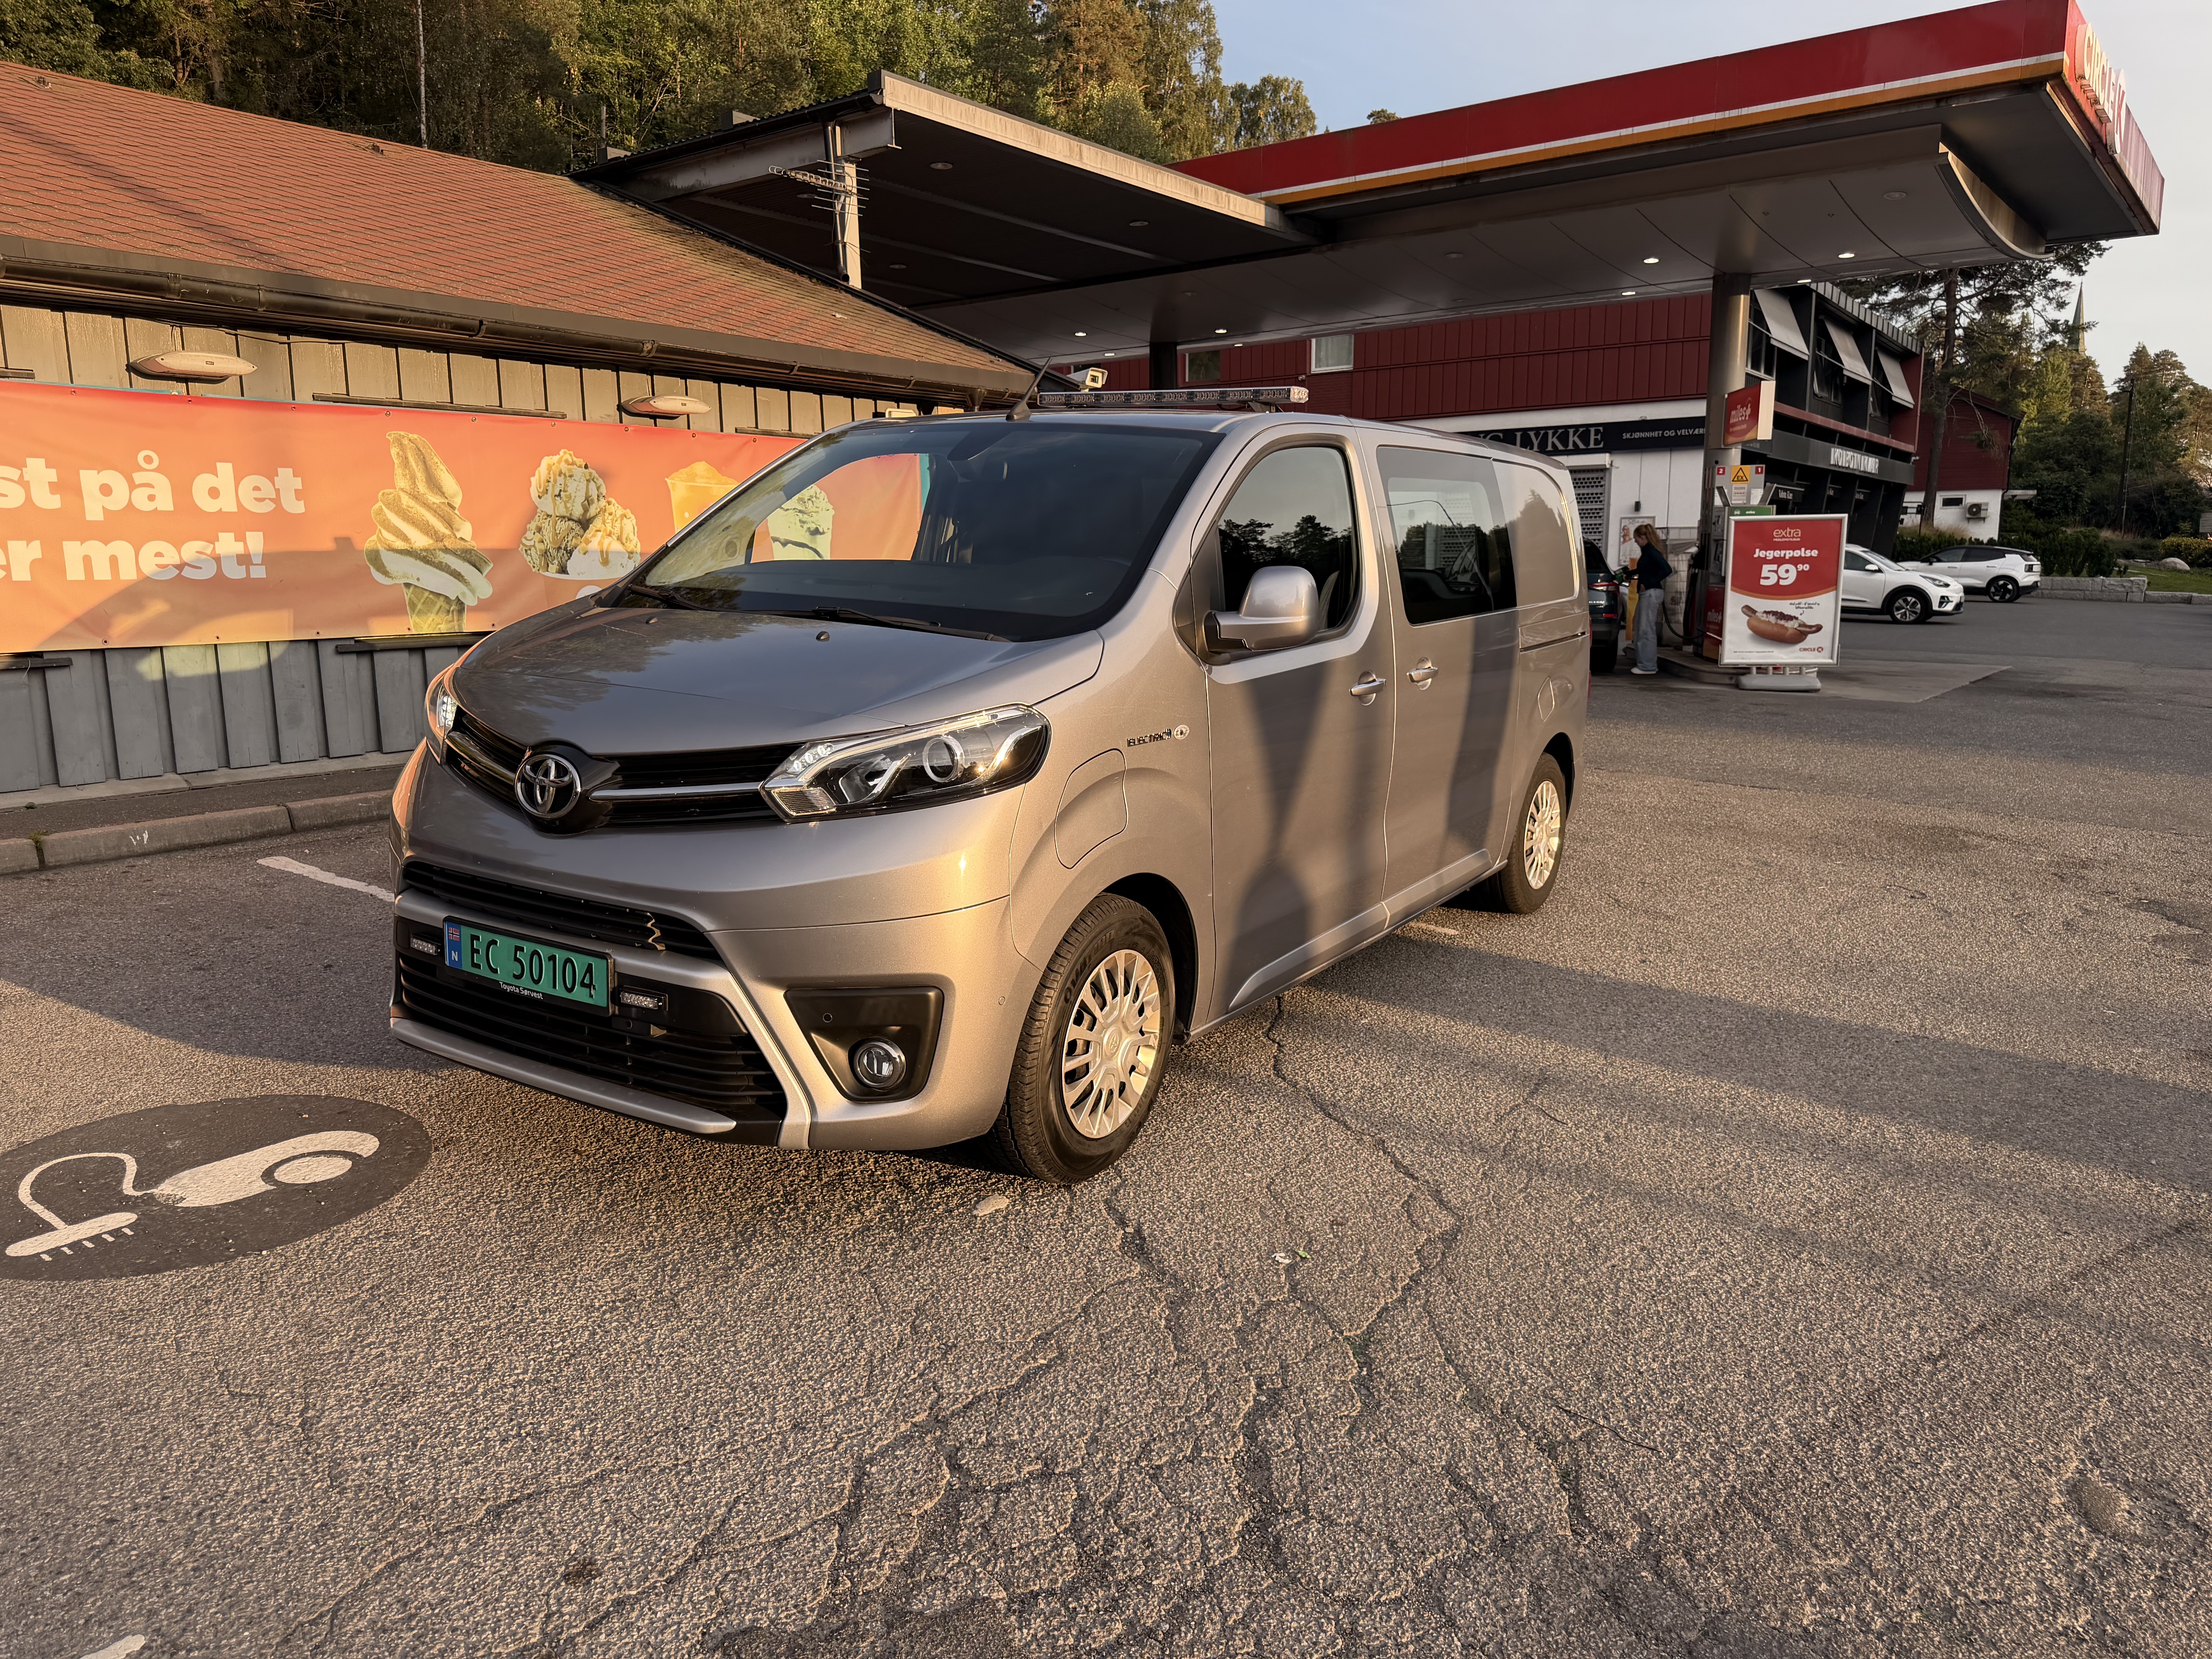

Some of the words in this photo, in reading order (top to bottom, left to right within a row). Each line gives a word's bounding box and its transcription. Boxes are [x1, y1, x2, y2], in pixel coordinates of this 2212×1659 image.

[2083, 22, 2116, 122] CIRCLE
[1515, 426, 1604, 452] LYKKE
[1622, 431, 1662, 439] SKJØNNHET
[79, 450, 174, 521] på
[192, 462, 305, 514] det
[1773, 527, 1801, 538] extra
[0, 540, 42, 581] r
[62, 532, 266, 580] mest!
[1753, 548, 1818, 560] Jegerpølse
[1760, 564, 1797, 586] 59
[452, 950, 458, 961] N
[470, 934, 500, 974] EC
[512, 945, 597, 999] 50104
[499, 981, 519, 992] Toyota
[520, 987, 543, 1000] Sørvest
